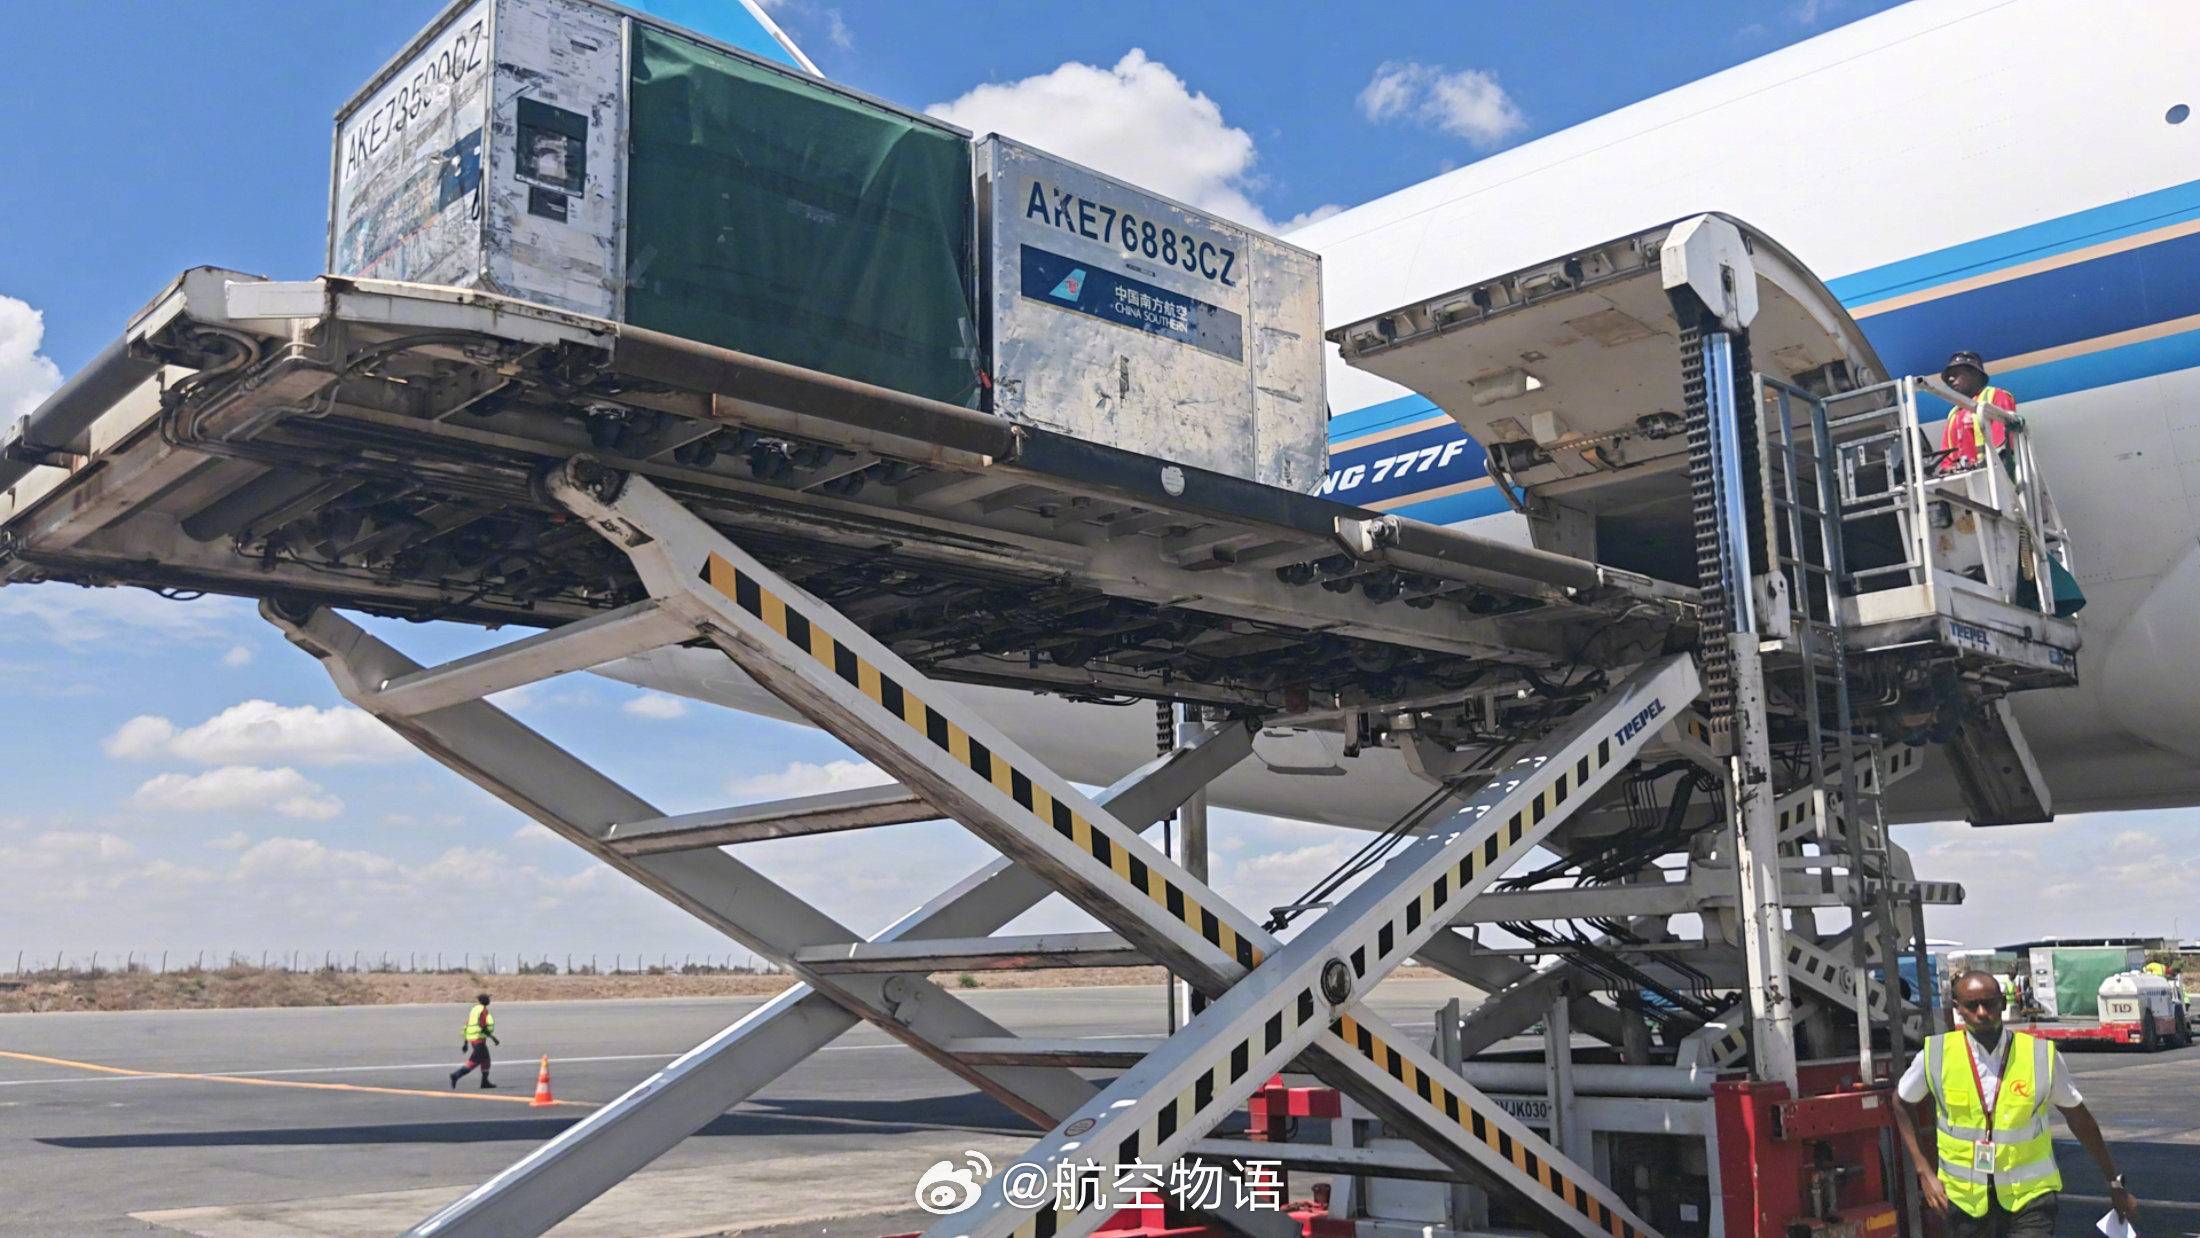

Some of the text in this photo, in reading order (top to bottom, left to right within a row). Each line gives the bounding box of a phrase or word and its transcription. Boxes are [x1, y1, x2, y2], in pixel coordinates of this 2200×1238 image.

[1026, 181, 1236, 287] AKE76883CZ
[1115, 285, 1188, 322] 中国南方航空
[1115, 302, 1188, 333] CHINA SOUTHERN
[1371, 439, 1468, 483] 777F
[1949, 621, 1990, 645] TREPEL
[1614, 697, 1666, 746] TREPEL
[2112, 1003, 2132, 1013] TLD
